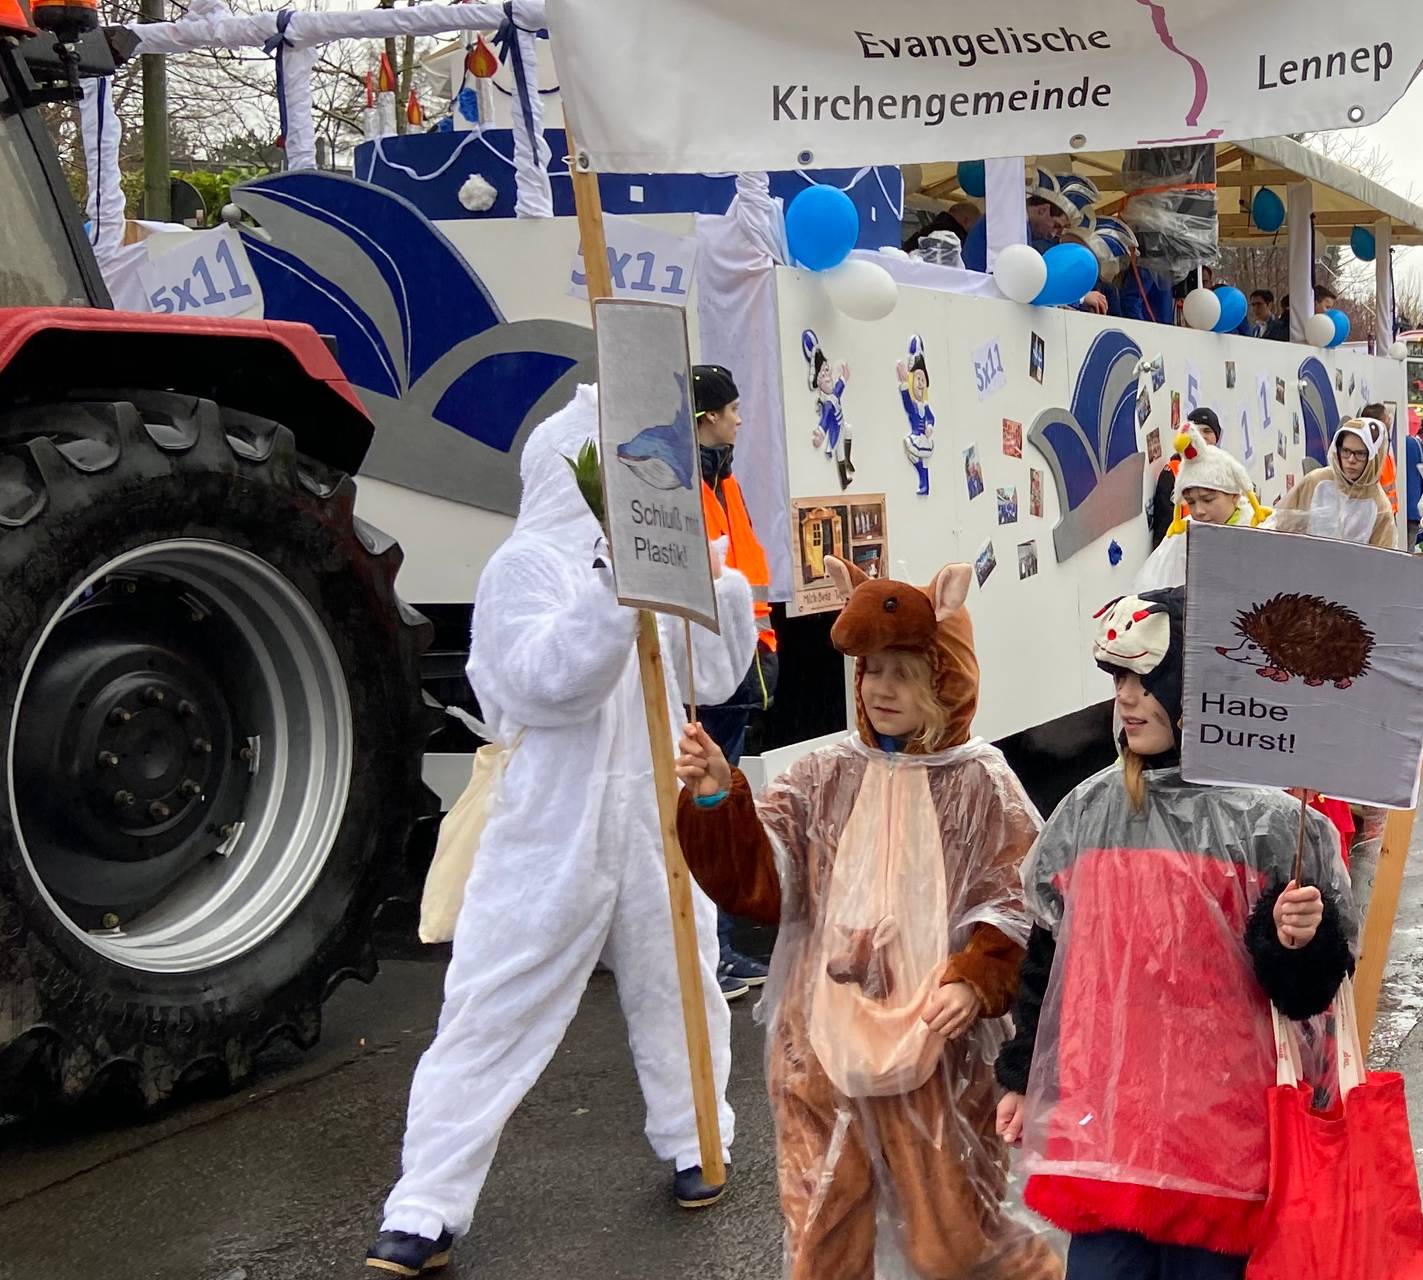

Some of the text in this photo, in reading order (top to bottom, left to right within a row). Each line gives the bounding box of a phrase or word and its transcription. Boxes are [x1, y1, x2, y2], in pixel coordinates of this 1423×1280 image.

[854, 27, 1111, 67] Evangelische
[1258, 42, 1393, 89] Lennep
[772, 76, 1111, 126] Kirchengemeinde
[1201, 692, 1289, 721] Habe
[1200, 723, 1295, 753] Durst!
